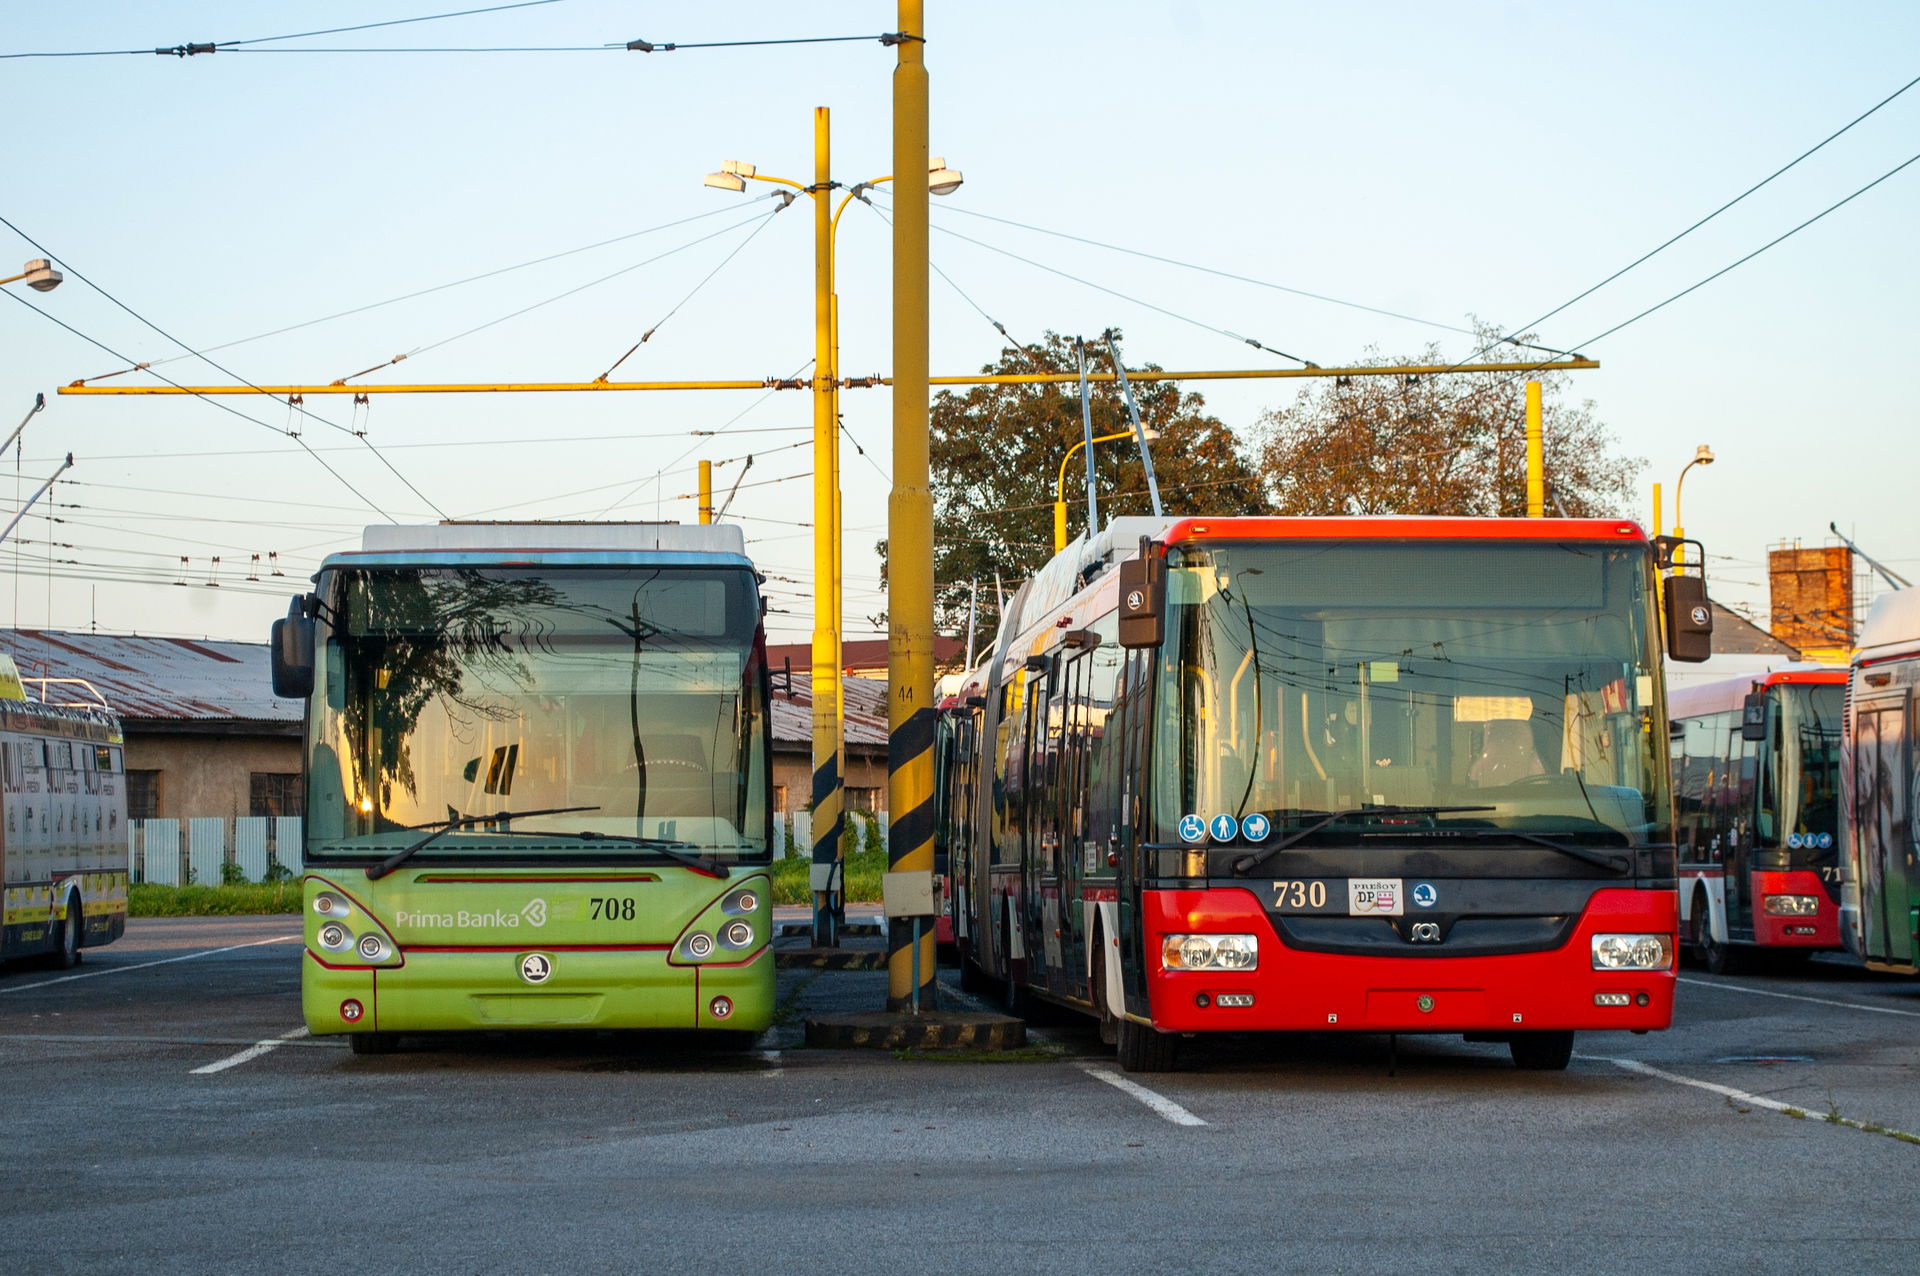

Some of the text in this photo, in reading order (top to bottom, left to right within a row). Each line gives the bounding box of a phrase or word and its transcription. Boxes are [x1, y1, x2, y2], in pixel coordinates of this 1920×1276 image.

[1273, 881, 1326, 908] 730
[1353, 882, 1397, 890] PREŠOV
[1358, 891, 1375, 903] DP
[396, 909, 519, 928] Prima Banka
[590, 898, 636, 921] 708
